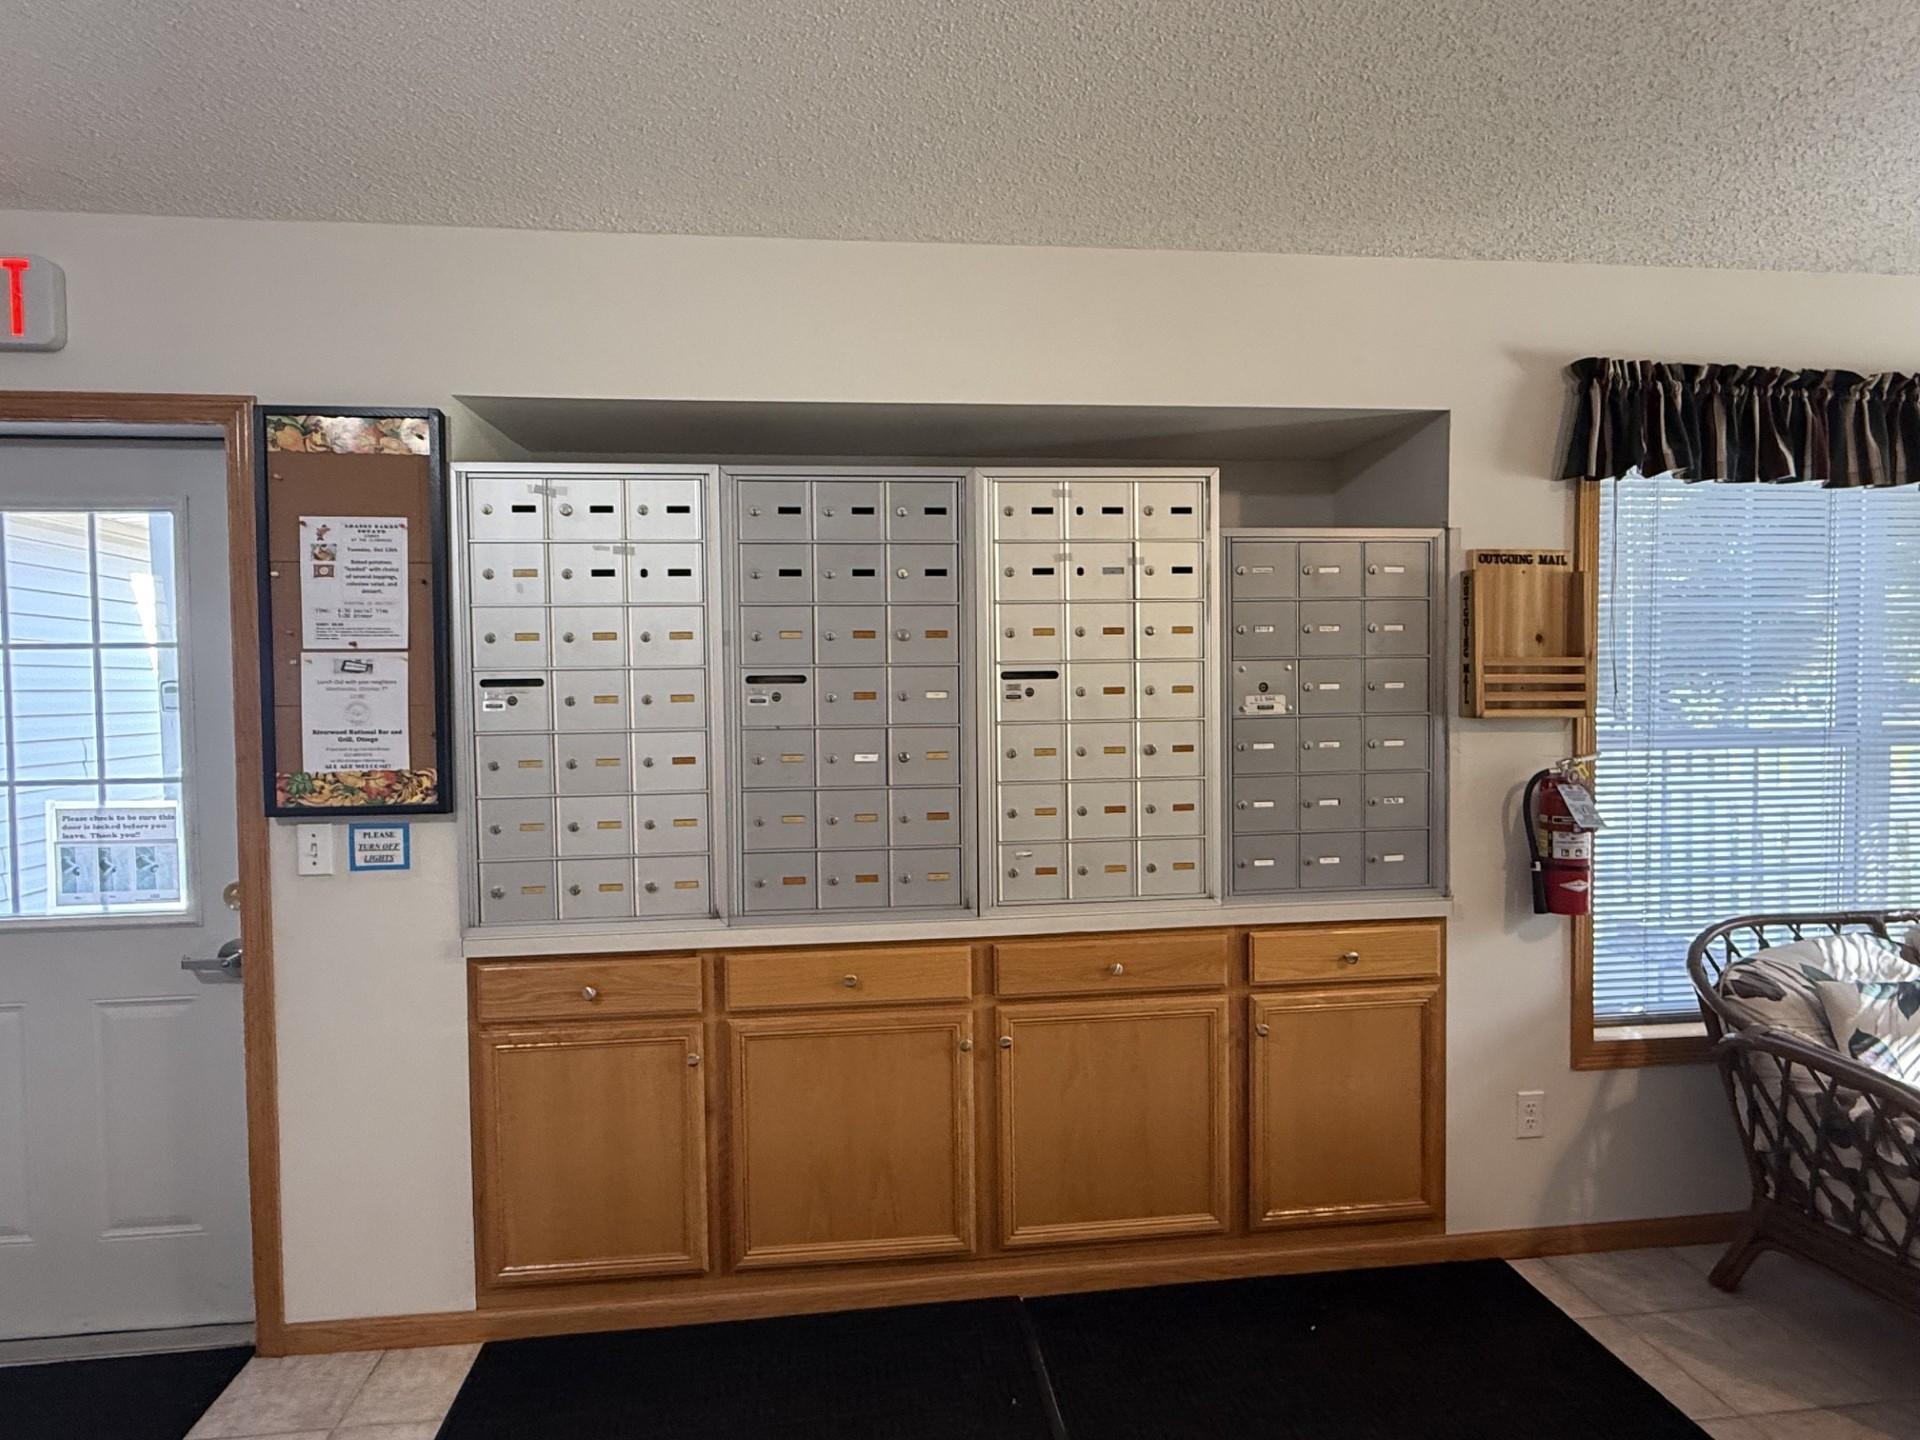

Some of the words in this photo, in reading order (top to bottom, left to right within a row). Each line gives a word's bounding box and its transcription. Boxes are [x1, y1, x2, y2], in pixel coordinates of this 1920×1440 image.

[0, 257, 31, 336] T
[1478, 554, 1533, 564] OUTGOING
[1538, 554, 1567, 565] MAIL
[363, 831, 396, 839] PLEASE
[358, 843, 381, 851] TURN
[382, 843, 400, 851] OFF
[364, 855, 395, 863] LIGHTS
